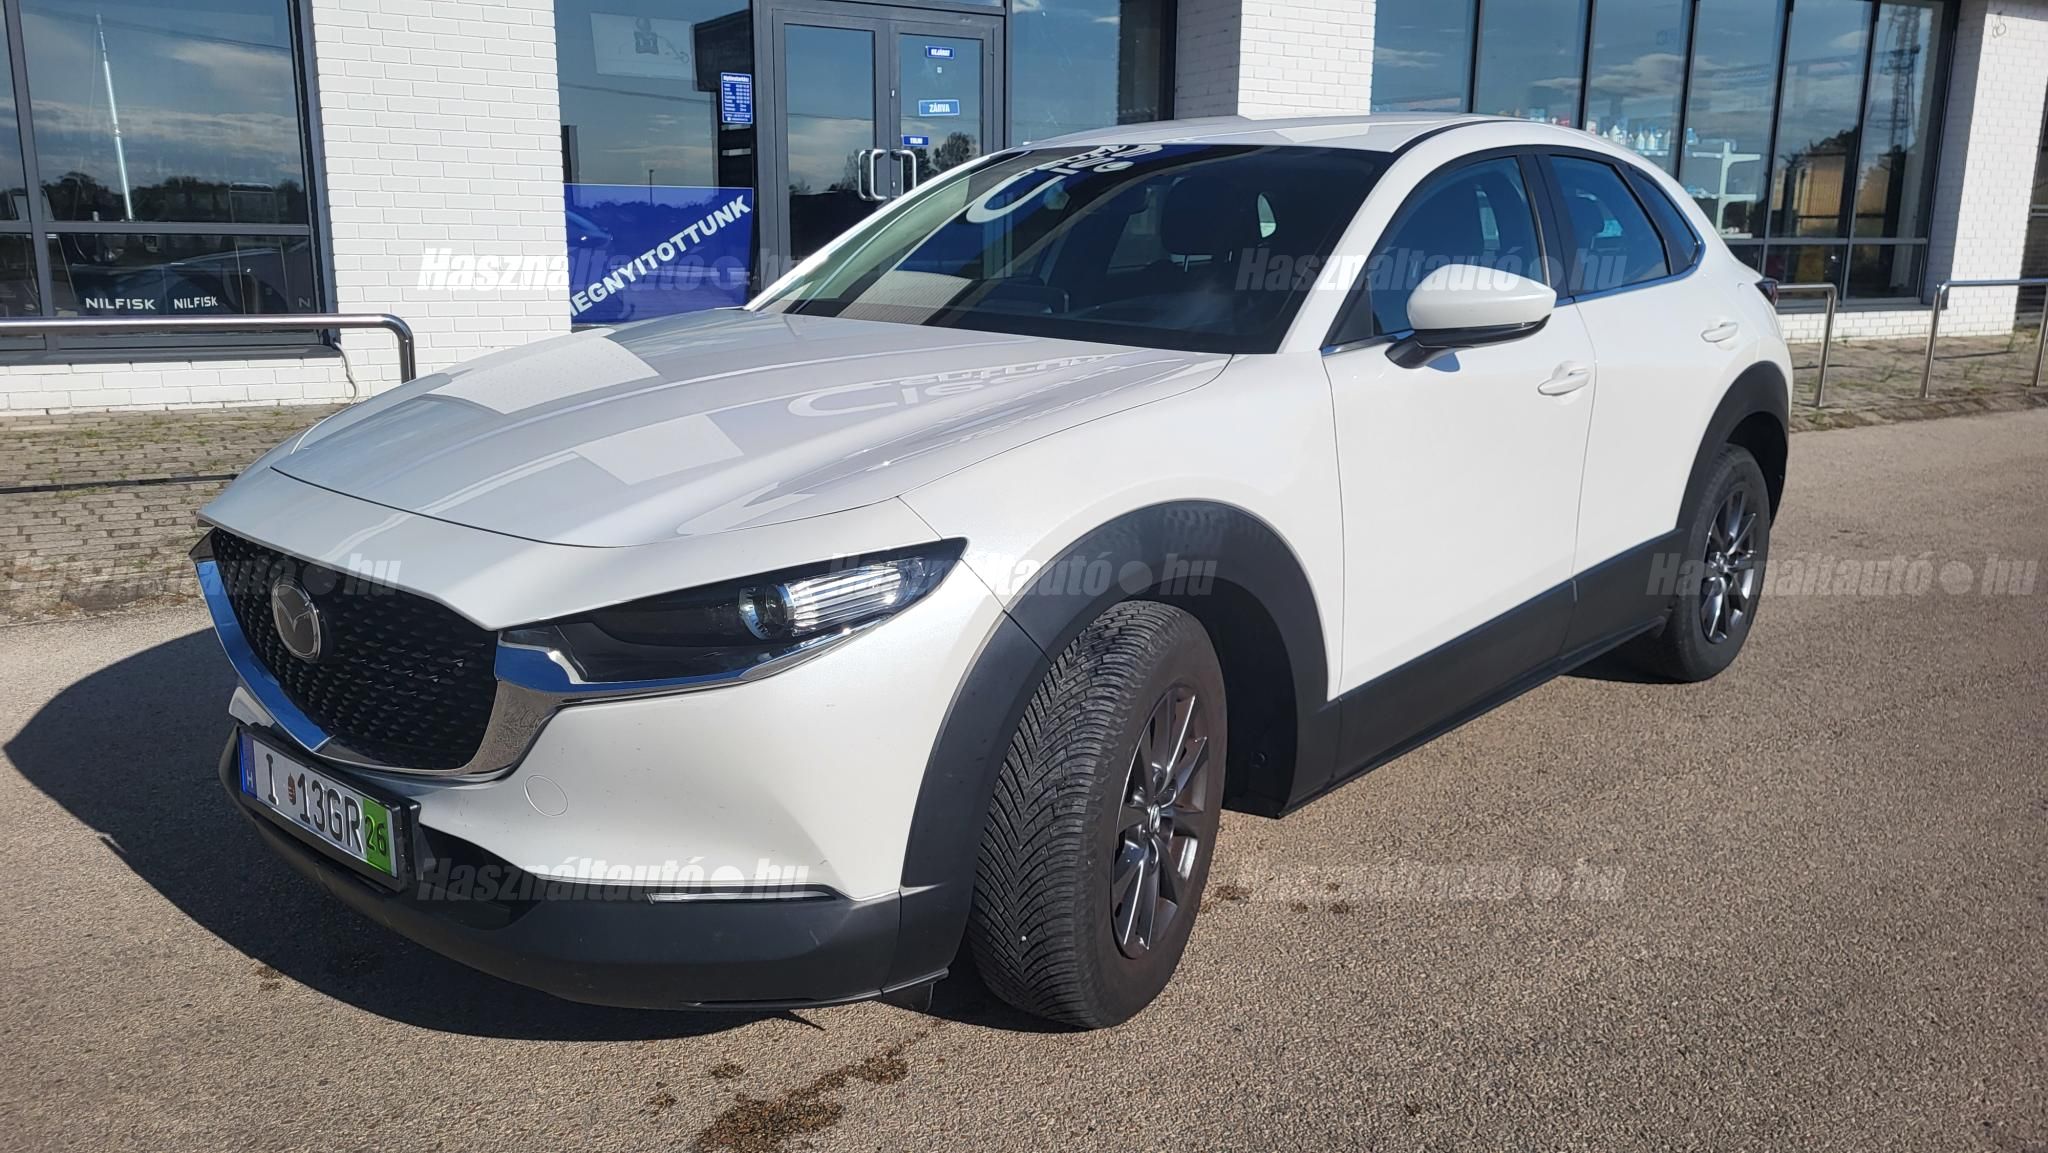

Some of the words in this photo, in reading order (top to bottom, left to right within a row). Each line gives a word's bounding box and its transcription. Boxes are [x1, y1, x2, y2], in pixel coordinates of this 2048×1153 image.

[928, 102, 951, 113] ZÁRVA
[85, 297, 156, 310] NILFISK
[173, 295, 218, 311] NILFISK
[365, 814, 388, 857] 26
